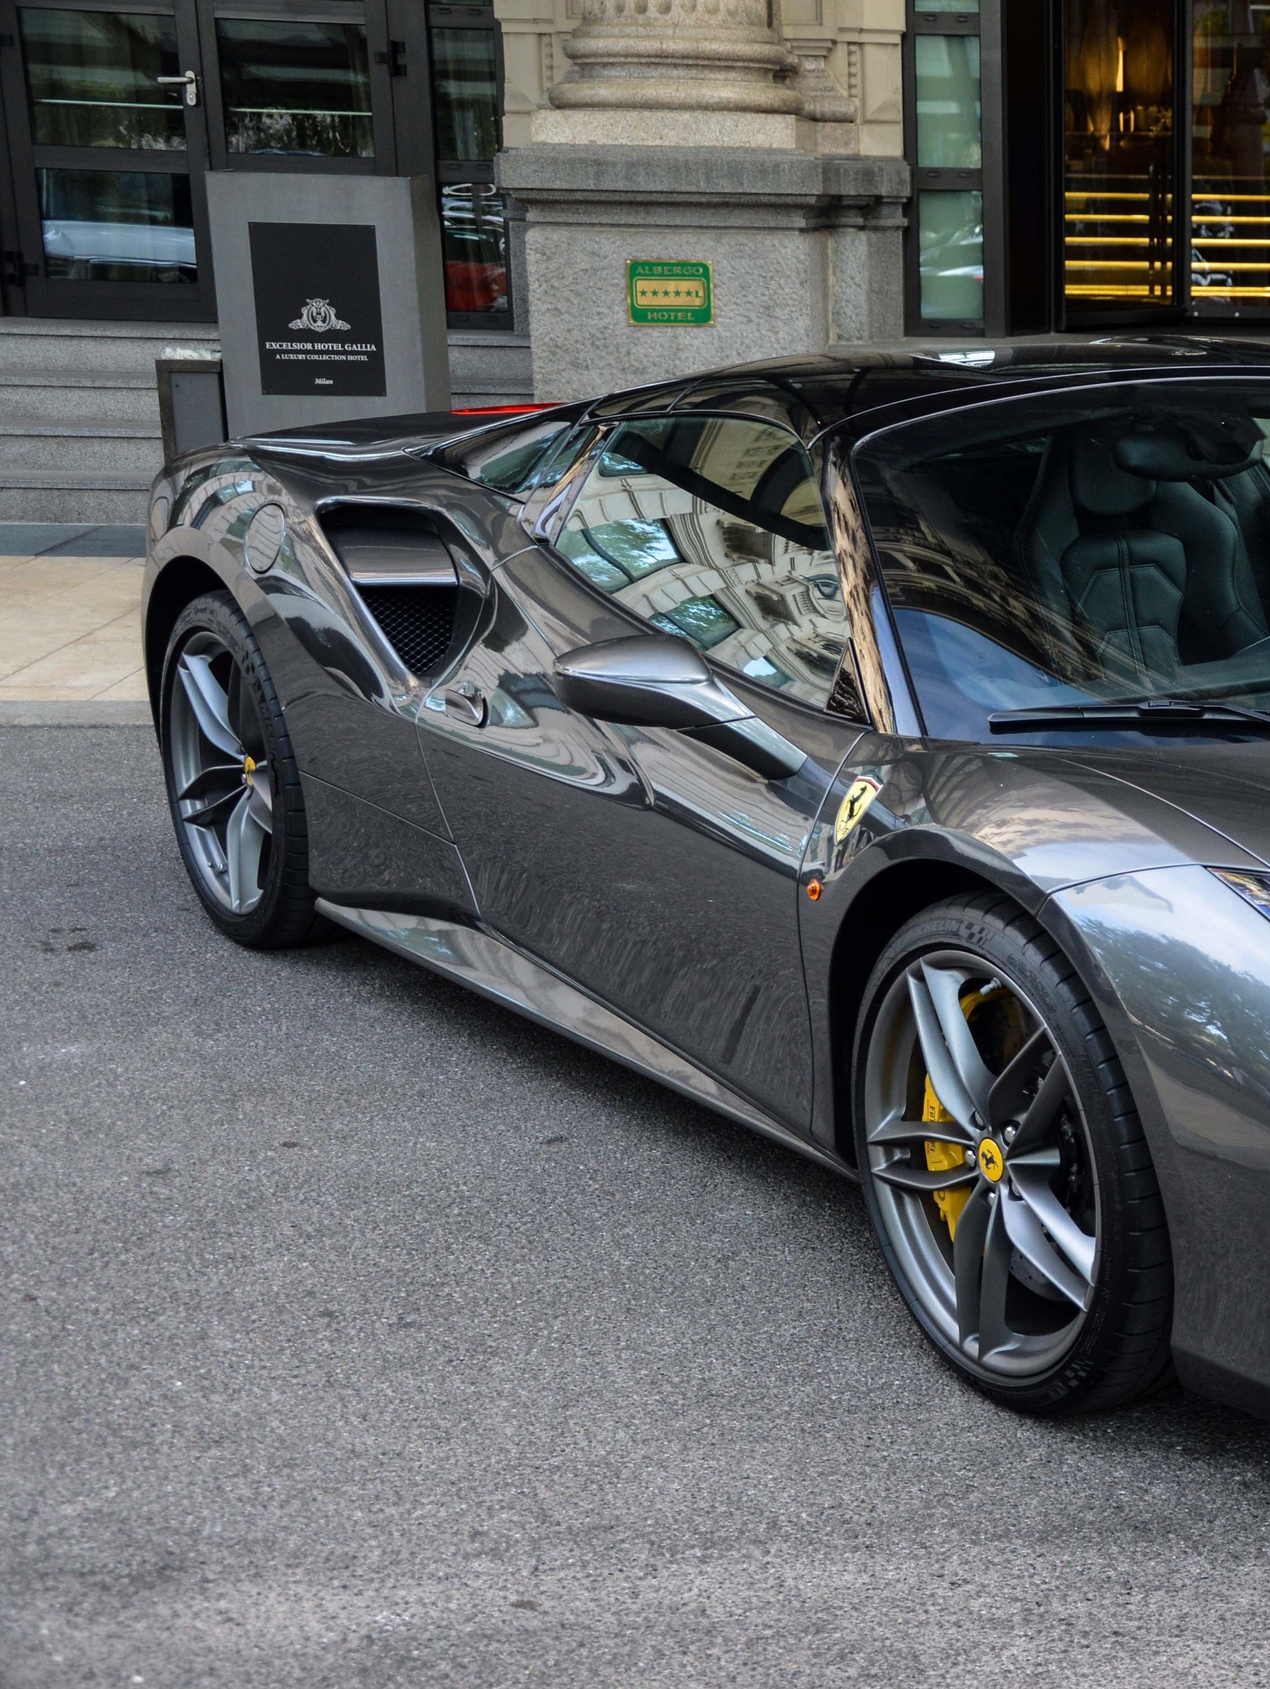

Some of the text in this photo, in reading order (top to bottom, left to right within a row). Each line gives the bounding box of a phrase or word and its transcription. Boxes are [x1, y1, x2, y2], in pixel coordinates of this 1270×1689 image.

[636, 266, 703, 275] ALBERGO
[647, 311, 695, 321] HOTEL
[265, 341, 377, 352] EXCELSIOR HOTEL GALLIA
[314, 377, 334, 385] Milan
